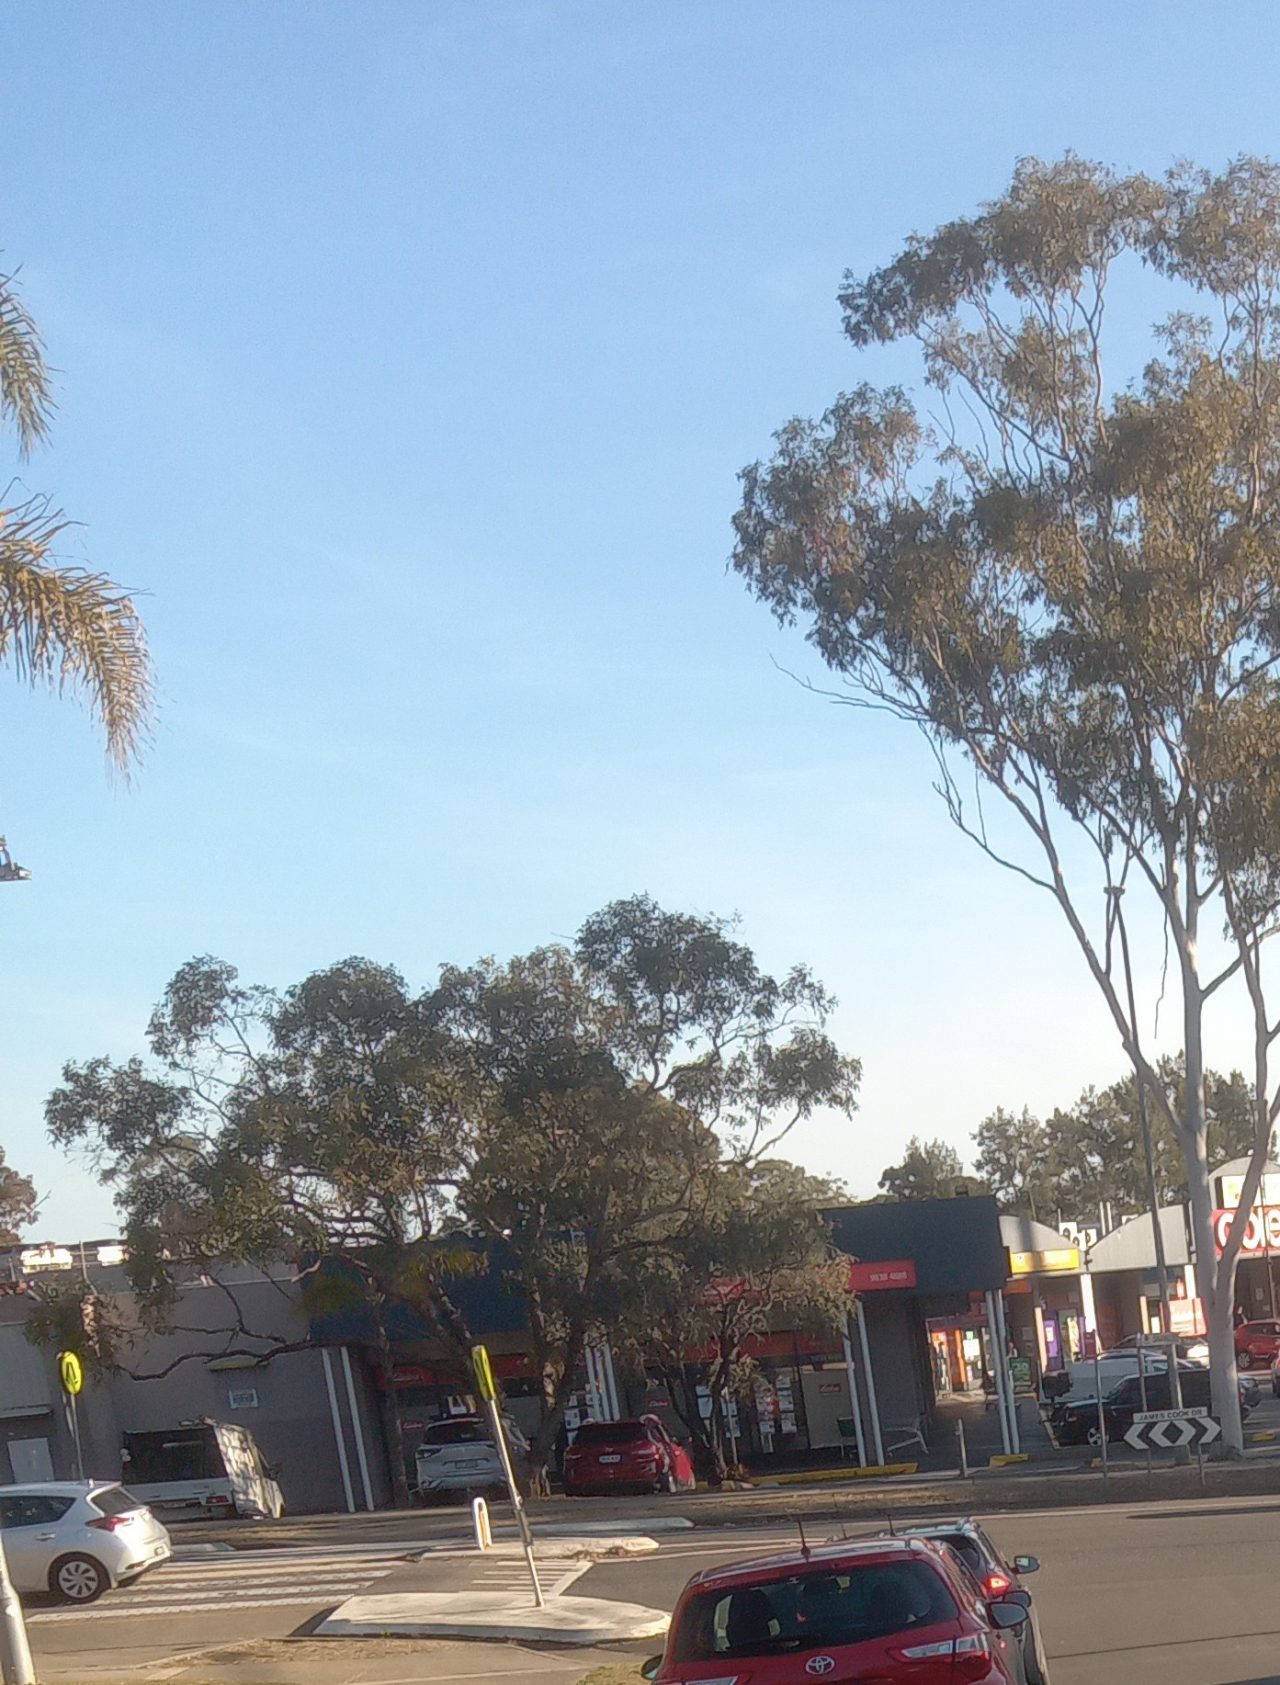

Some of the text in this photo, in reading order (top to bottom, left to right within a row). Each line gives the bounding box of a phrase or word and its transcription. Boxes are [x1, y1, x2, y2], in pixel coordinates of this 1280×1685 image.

[1139, 1408, 1202, 1421] JAMES COOK DR
